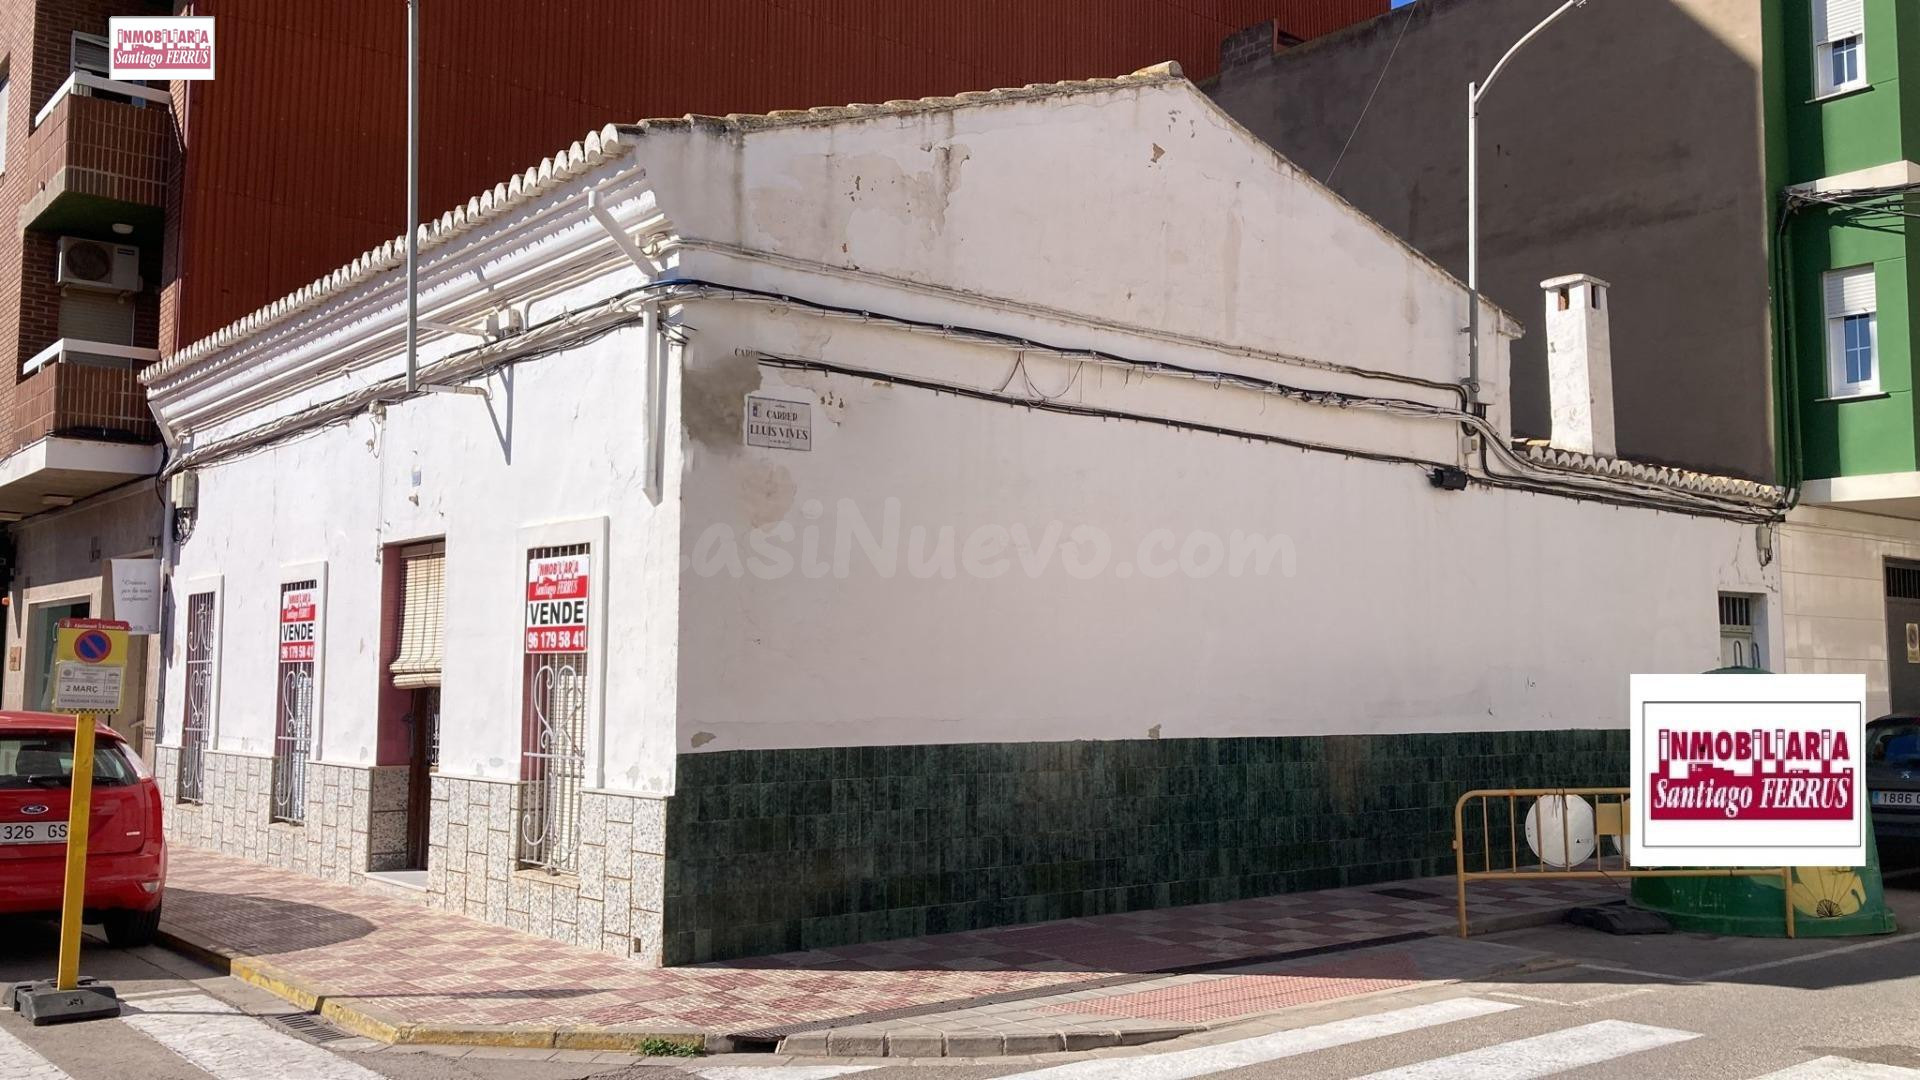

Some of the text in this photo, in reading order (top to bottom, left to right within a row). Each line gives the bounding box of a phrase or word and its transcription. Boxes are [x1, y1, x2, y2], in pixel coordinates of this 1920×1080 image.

[766, 410, 798, 421] CARRER
[778, 427, 808, 440] VIVES
[530, 600, 584, 625] VENDE
[283, 623, 313, 641] VENDE
[528, 630, 584, 649] 96 179 58 41
[1884, 793, 1912, 804] 1886
[4, 824, 68, 839] 326 GS
